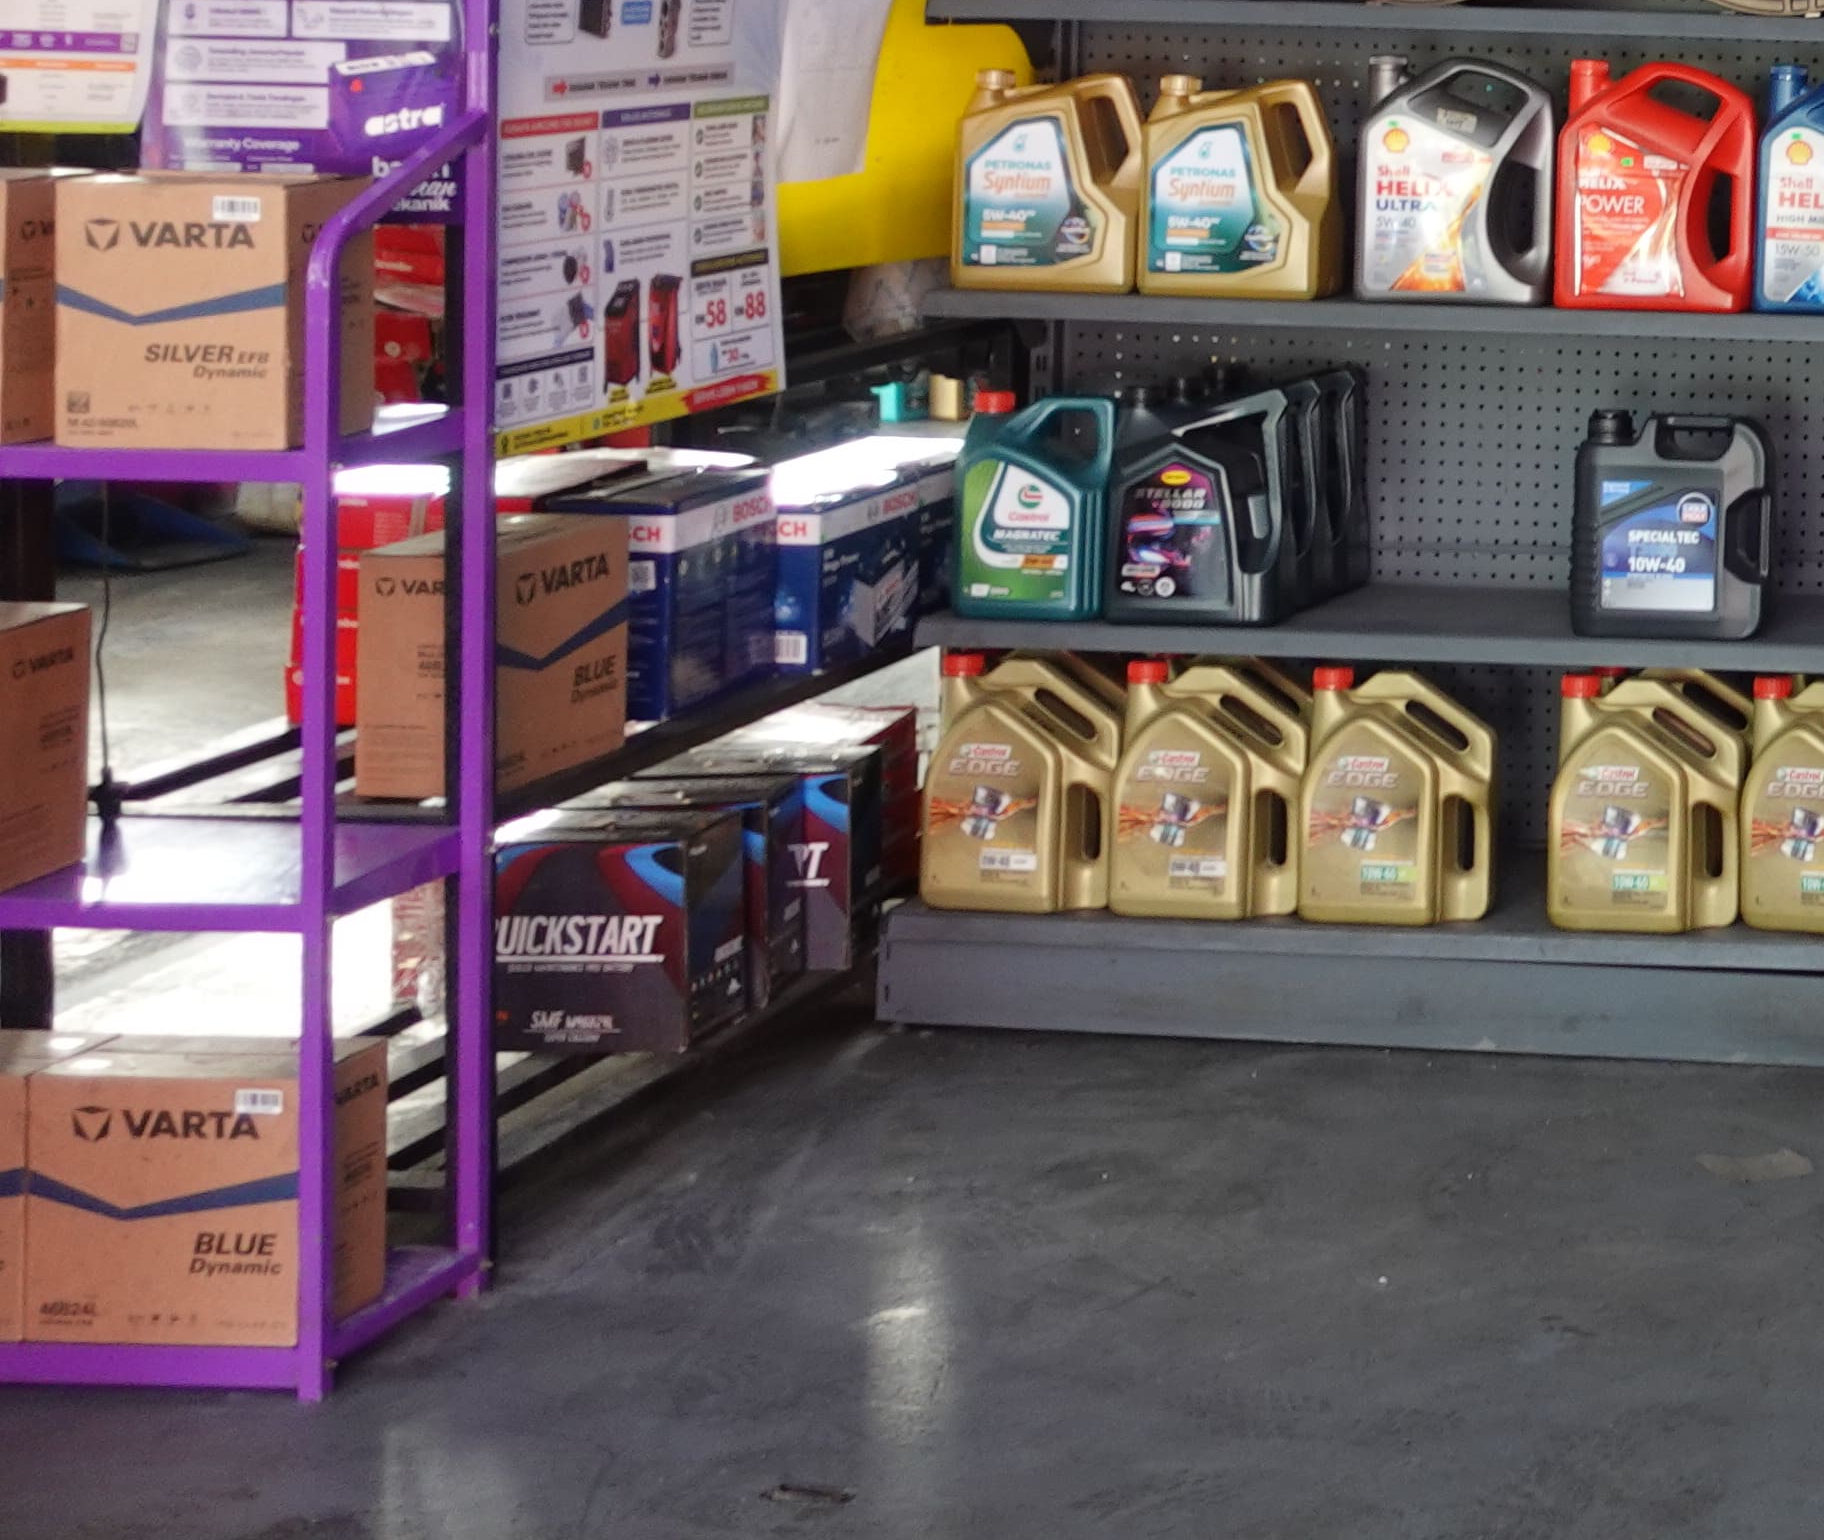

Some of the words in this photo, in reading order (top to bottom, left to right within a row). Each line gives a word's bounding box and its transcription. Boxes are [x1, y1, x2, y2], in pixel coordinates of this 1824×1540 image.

[364, 103, 442, 137] astra
[242, 137, 300, 154] Coverage
[984, 159, 1052, 171] PETRONAS
[1169, 165, 1236, 179] PETRONAS
[1376, 165, 1411, 179] Shell
[983, 171, 1051, 194] Syntium
[1168, 179, 1235, 199] Syntium
[1375, 180, 1456, 198] HELIX
[1778, 176, 1814, 189] Shell
[1375, 199, 1439, 212] ULTRA
[1579, 195, 1646, 216] POWER
[1776, 215, 1806, 225] HIGH
[128, 221, 256, 250] VARTA
[143, 343, 234, 363] SILVER
[193, 364, 268, 380] Dynamic
[1007, 510, 1051, 523] Castrol
[992, 529, 1063, 542] MAGNATEC
[540, 553, 611, 594] VARTA
[1627, 556, 1687, 573] 10W-40
[401, 579, 446, 596] VAR
[574, 655, 617, 687] BLUE
[950, 759, 1021, 777] EDGE
[1136, 766, 1211, 783] EDGE
[1325, 771, 1400, 788] EDGE
[1576, 780, 1650, 798] EDGE
[495, 914, 664, 955] UICKSTART
[121, 1110, 260, 1140] VARTA
[193, 1232, 278, 1257] BLUE
[188, 1258, 283, 1278] Dynamic
